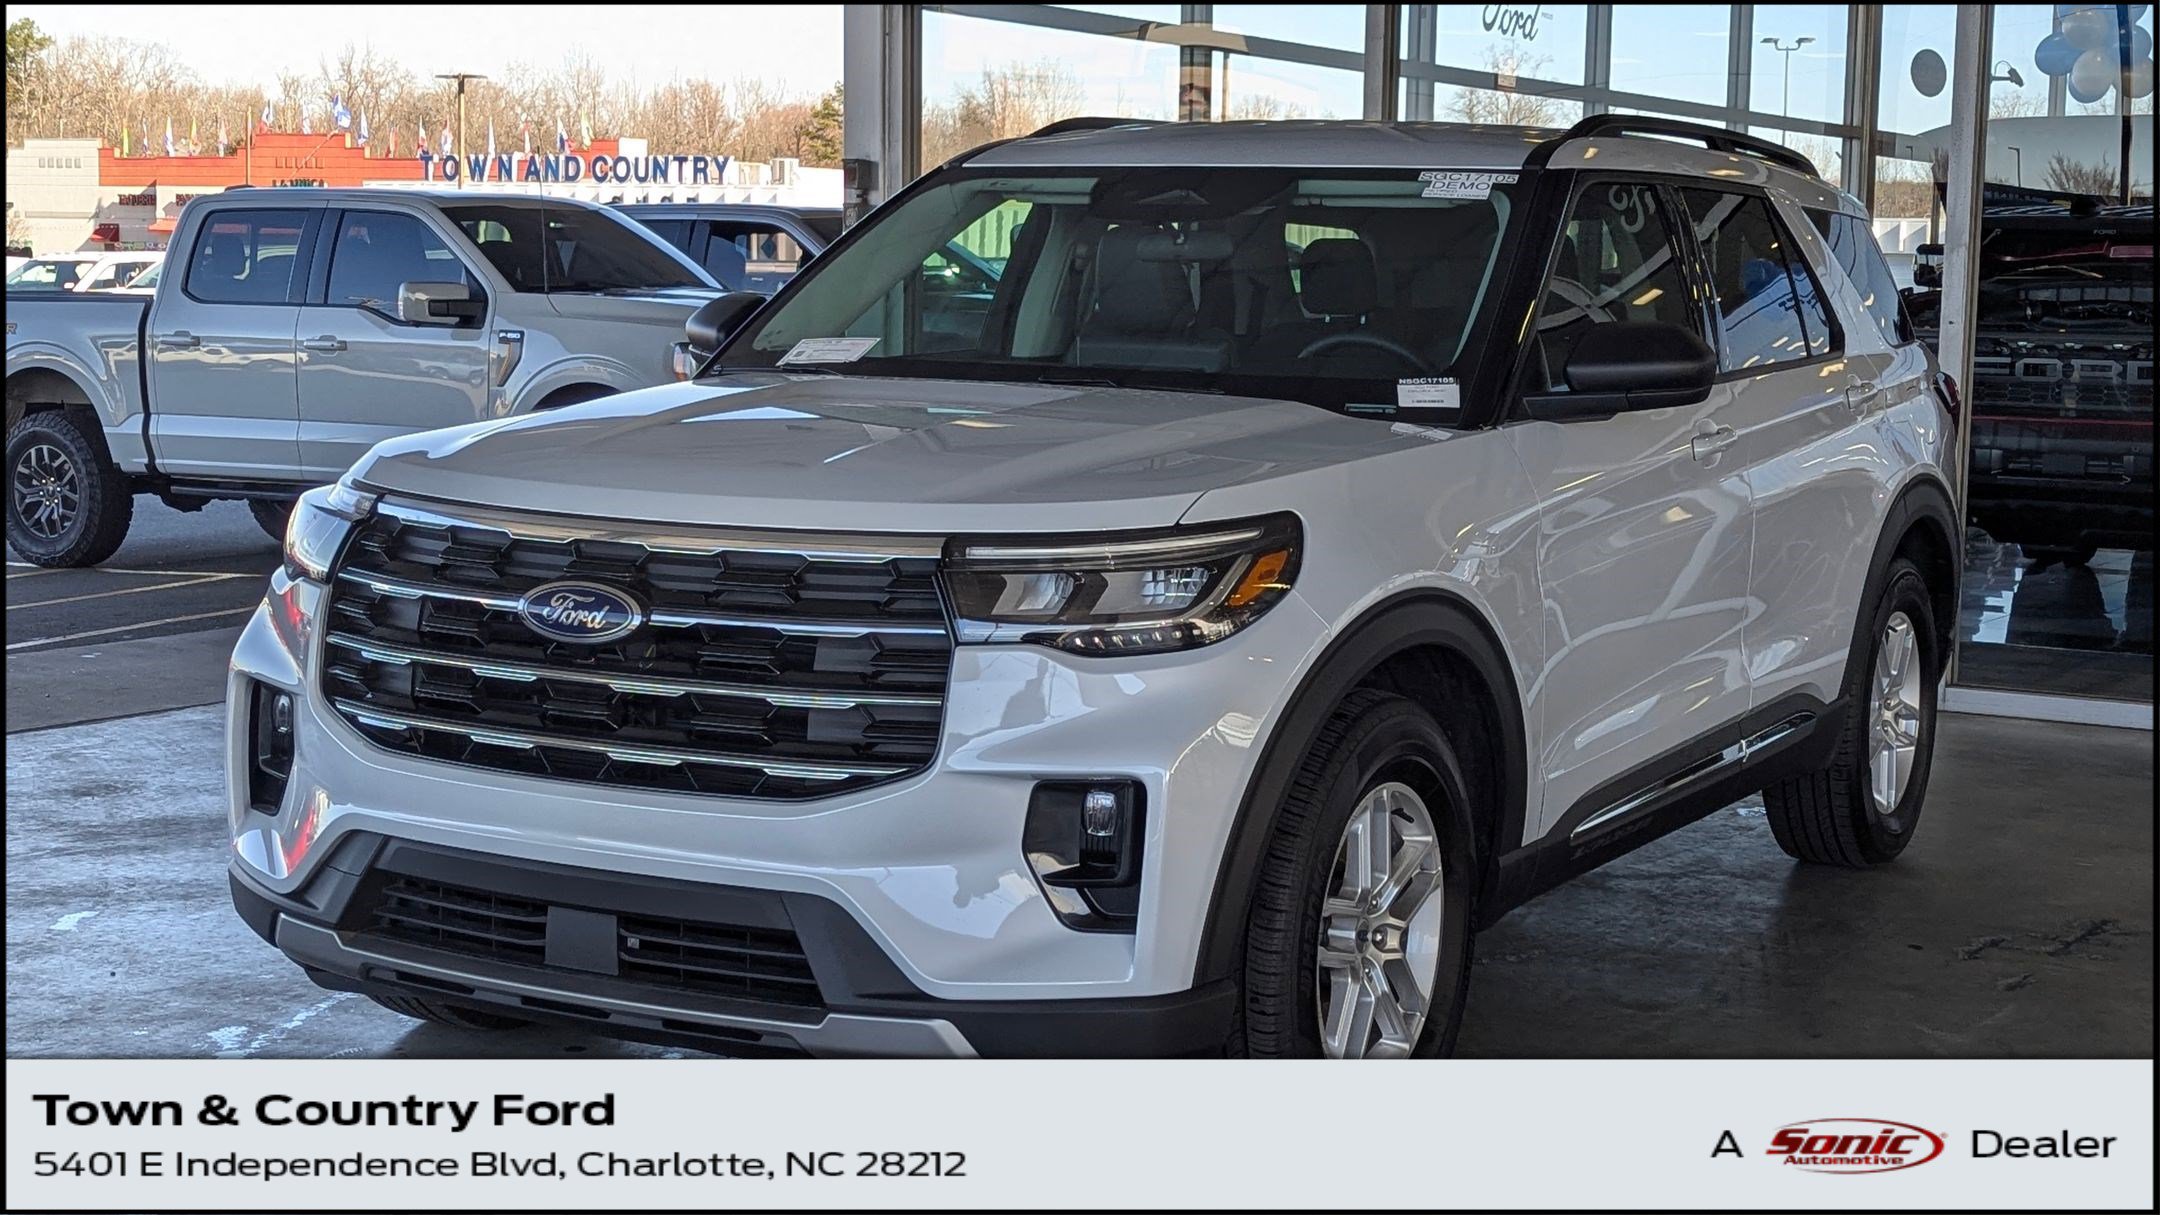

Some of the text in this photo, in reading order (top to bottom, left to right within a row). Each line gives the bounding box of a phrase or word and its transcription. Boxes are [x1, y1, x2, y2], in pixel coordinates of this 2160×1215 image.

[420, 154, 732, 185] TOWN AND COUNTRY
[1432, 181, 1490, 191] DEMO
[542, 593, 610, 629] Ford
